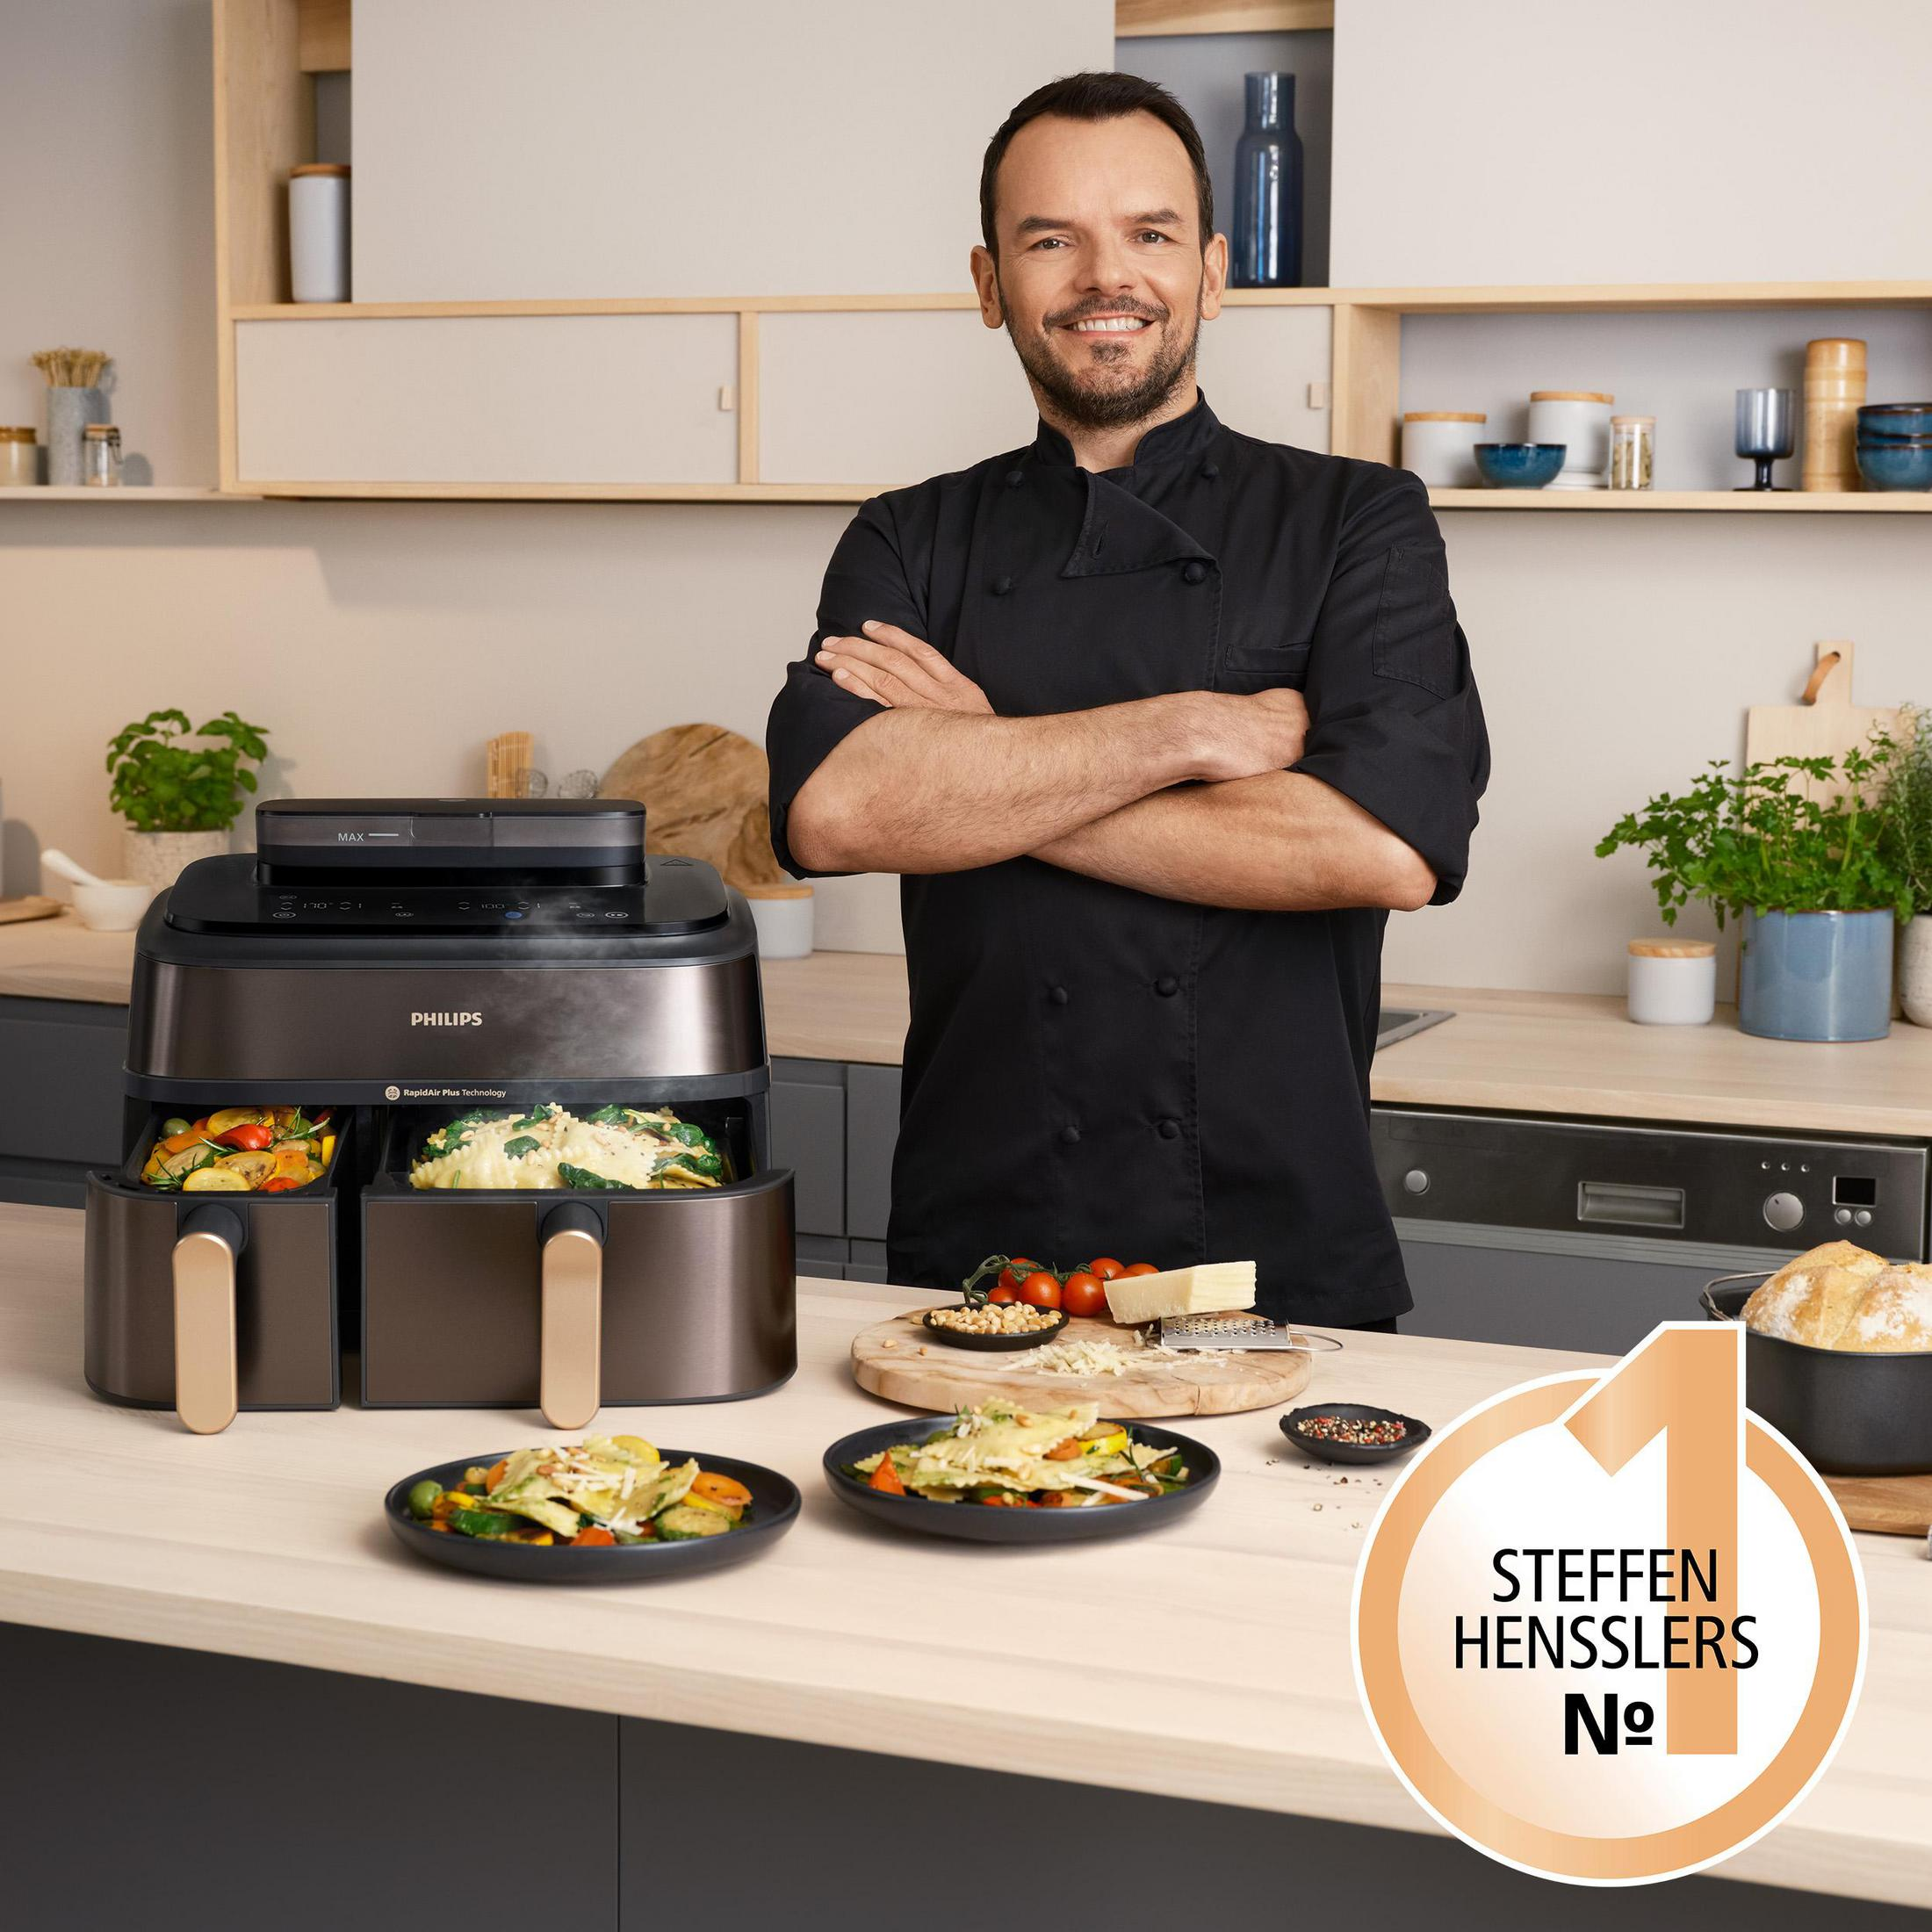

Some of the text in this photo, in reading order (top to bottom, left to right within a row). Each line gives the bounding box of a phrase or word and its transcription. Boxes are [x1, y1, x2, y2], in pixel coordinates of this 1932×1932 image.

[337, 833, 364, 842] MAX
[411, 1012, 483, 1026] PHILIPS
[403, 1088, 507, 1099] RapidAir Plus Technology
